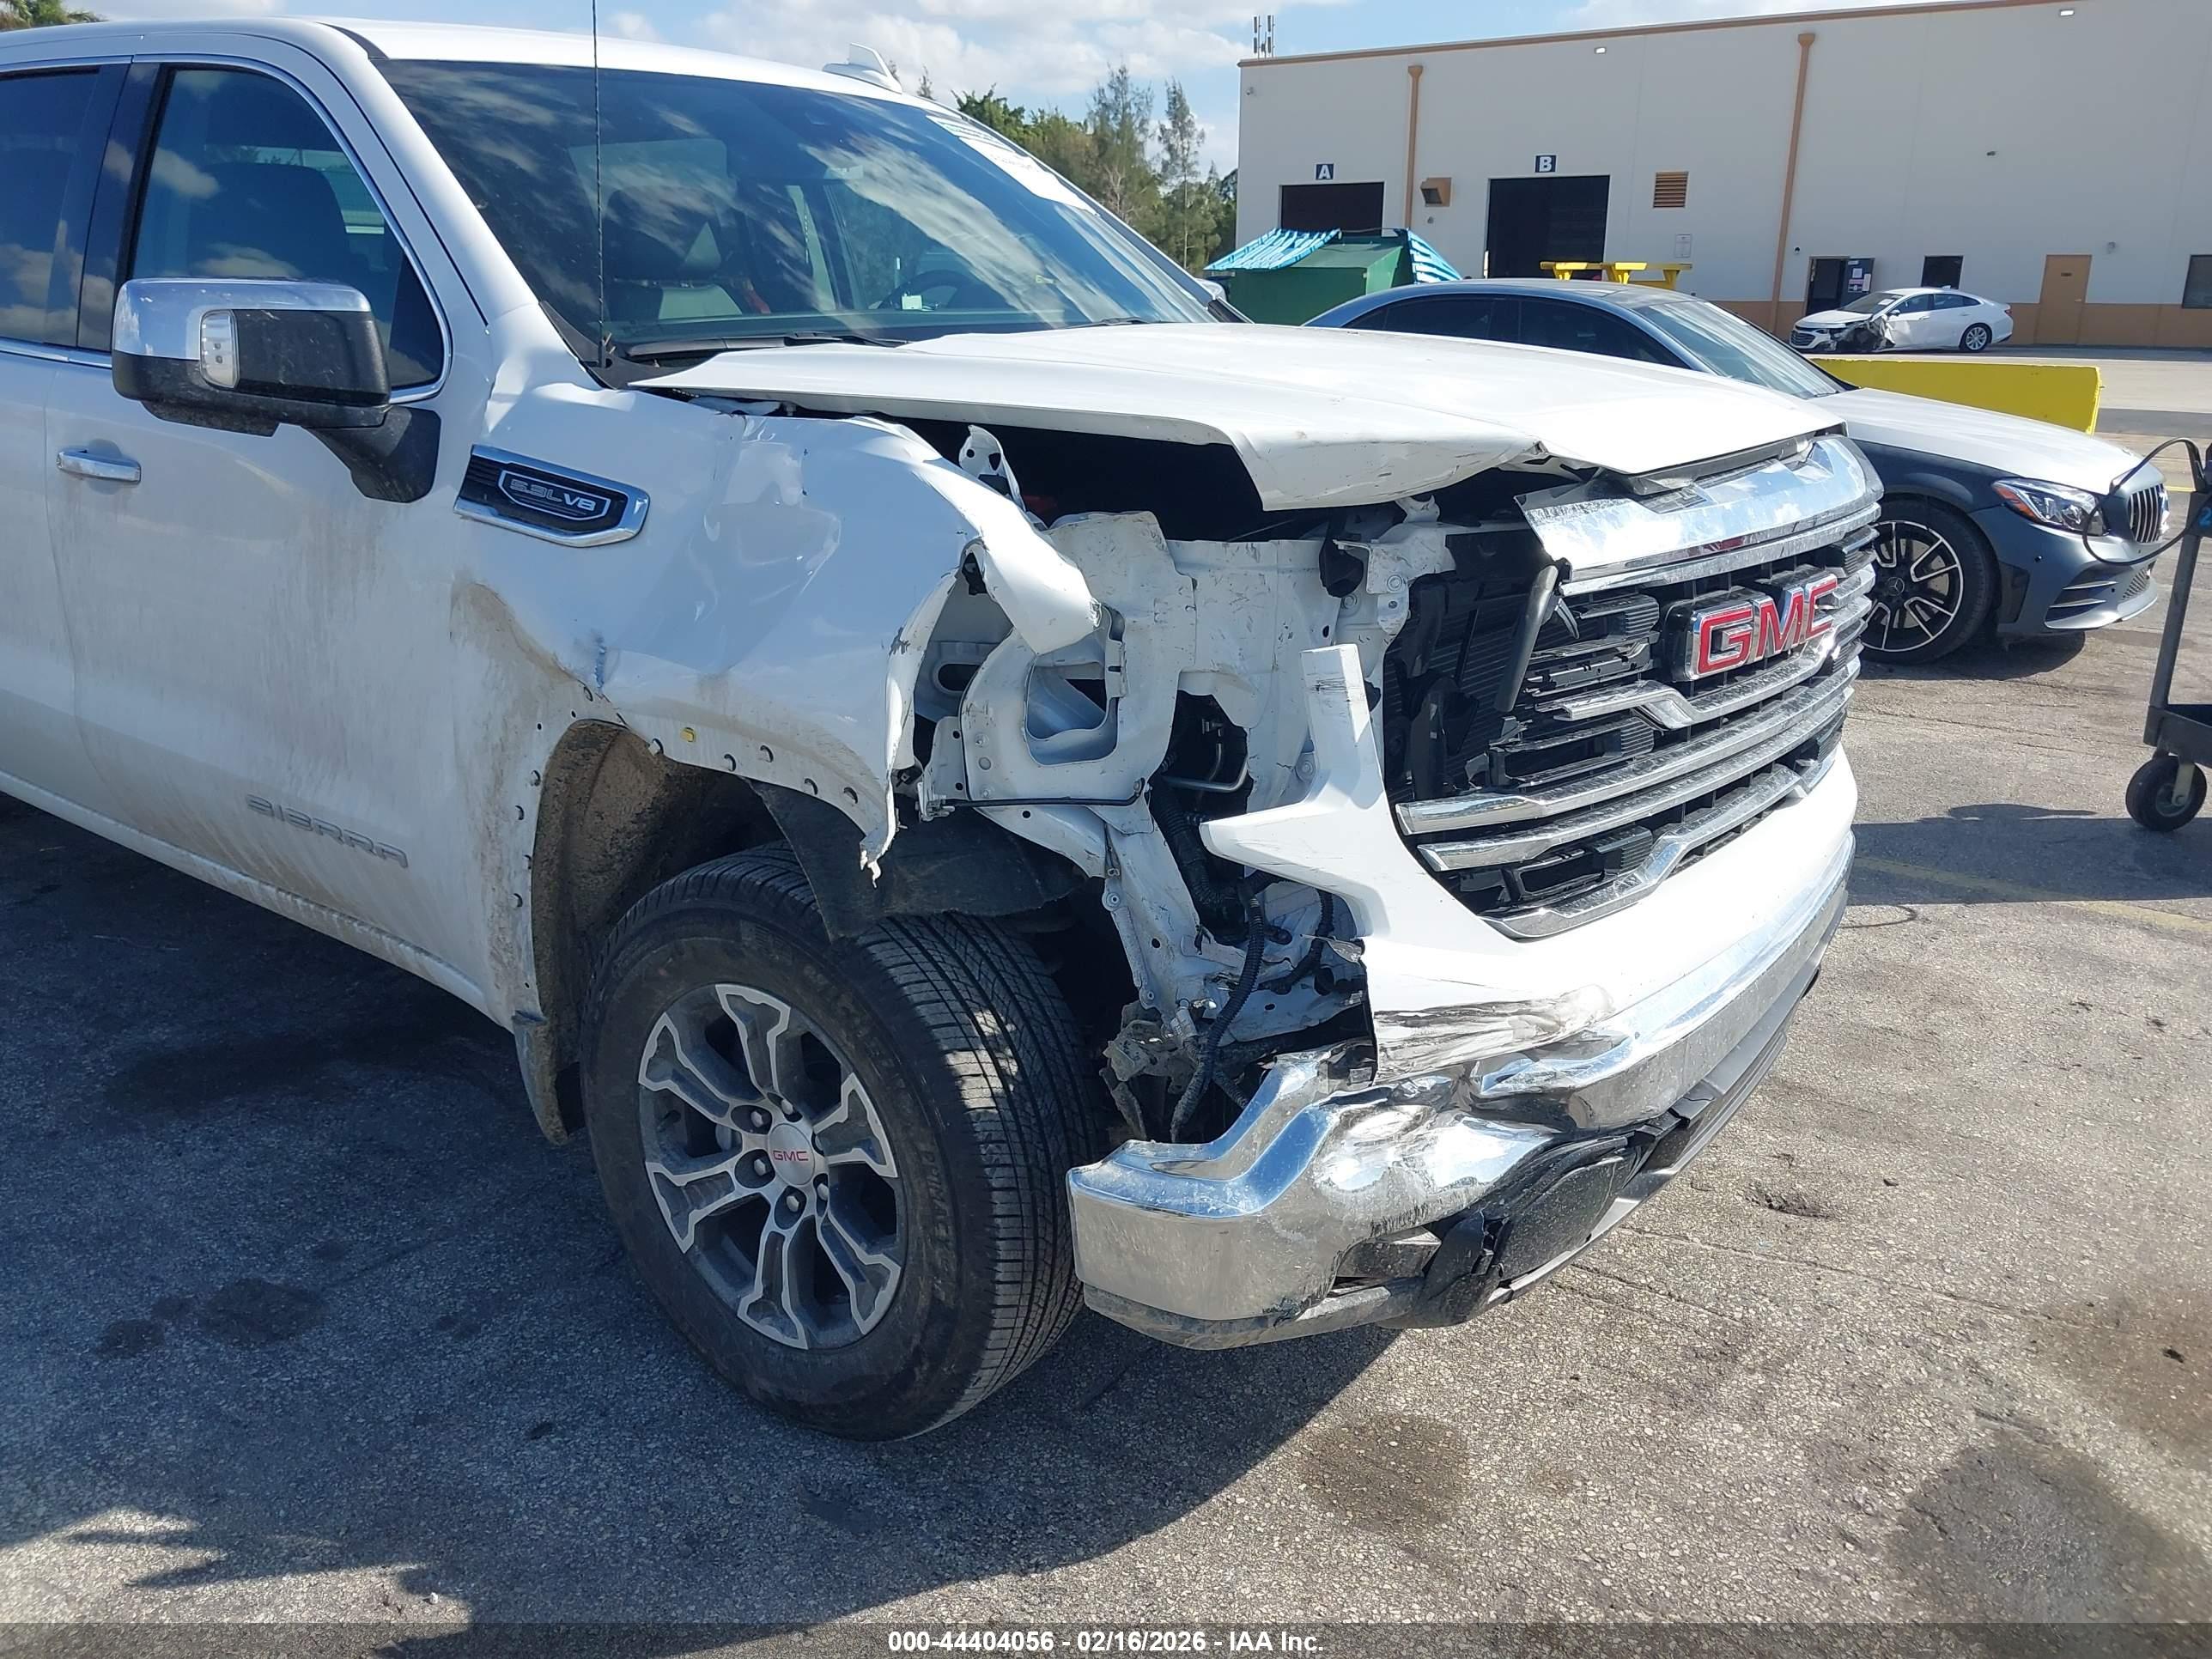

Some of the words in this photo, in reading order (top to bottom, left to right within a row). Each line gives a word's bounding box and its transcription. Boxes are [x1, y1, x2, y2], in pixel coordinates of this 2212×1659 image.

[1318, 164, 1331, 179] A
[1539, 156, 1552, 172] B
[1695, 574, 1838, 677] GMC
[246, 793, 408, 868] SIERRA
[773, 1150, 808, 1161] GMC
